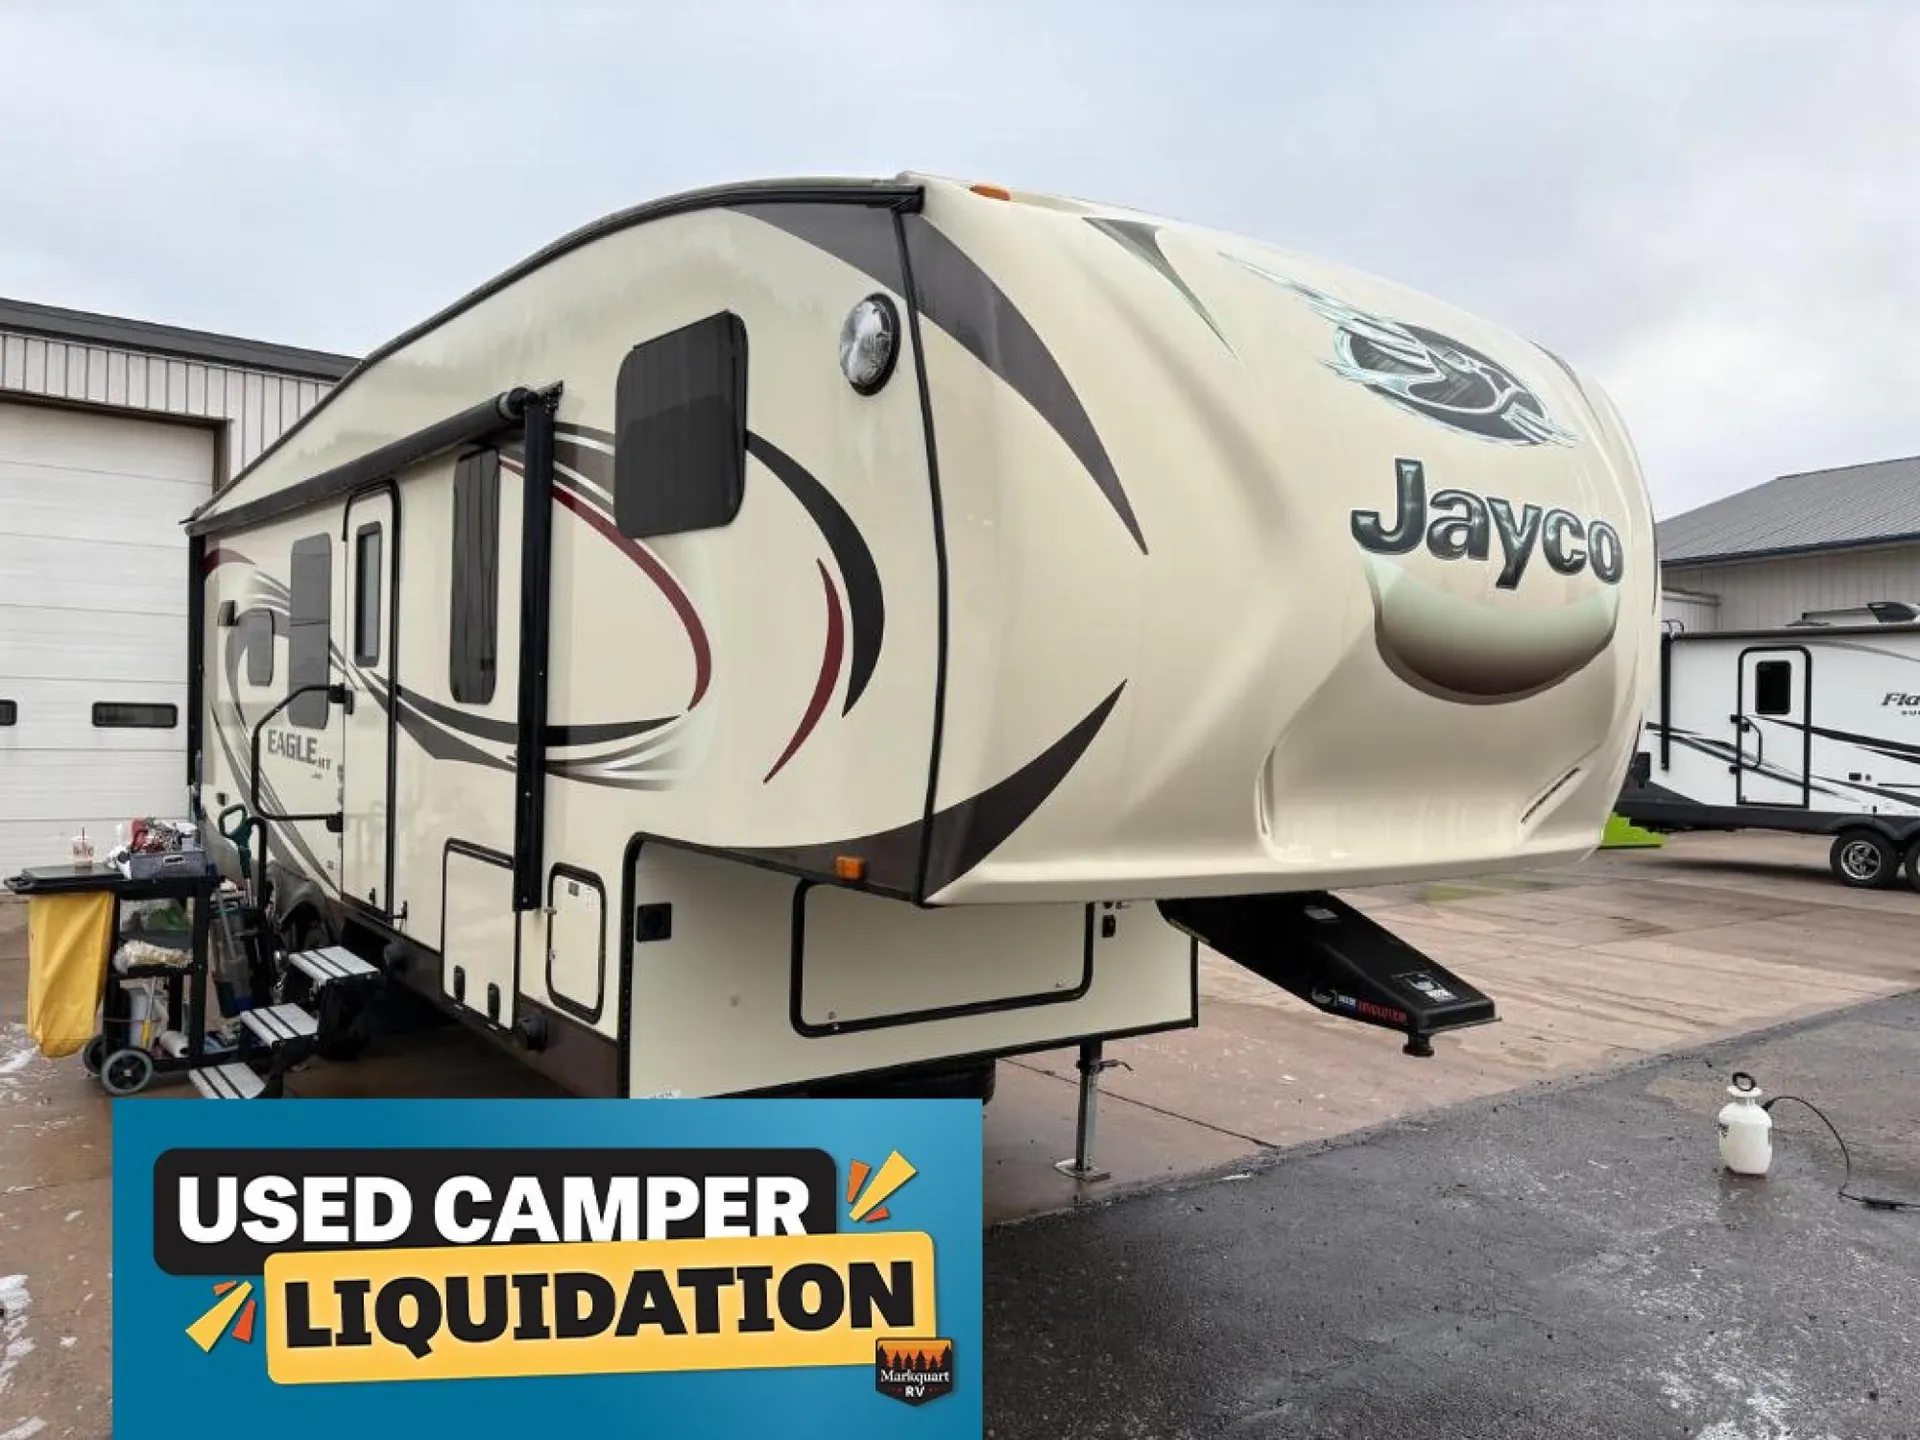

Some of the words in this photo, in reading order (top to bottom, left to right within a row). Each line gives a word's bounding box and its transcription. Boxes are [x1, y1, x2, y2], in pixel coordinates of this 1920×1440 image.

[1350, 458, 1624, 590] Jayco
[1881, 692, 1920, 706] Fla
[267, 729, 318, 765] EAGLE
